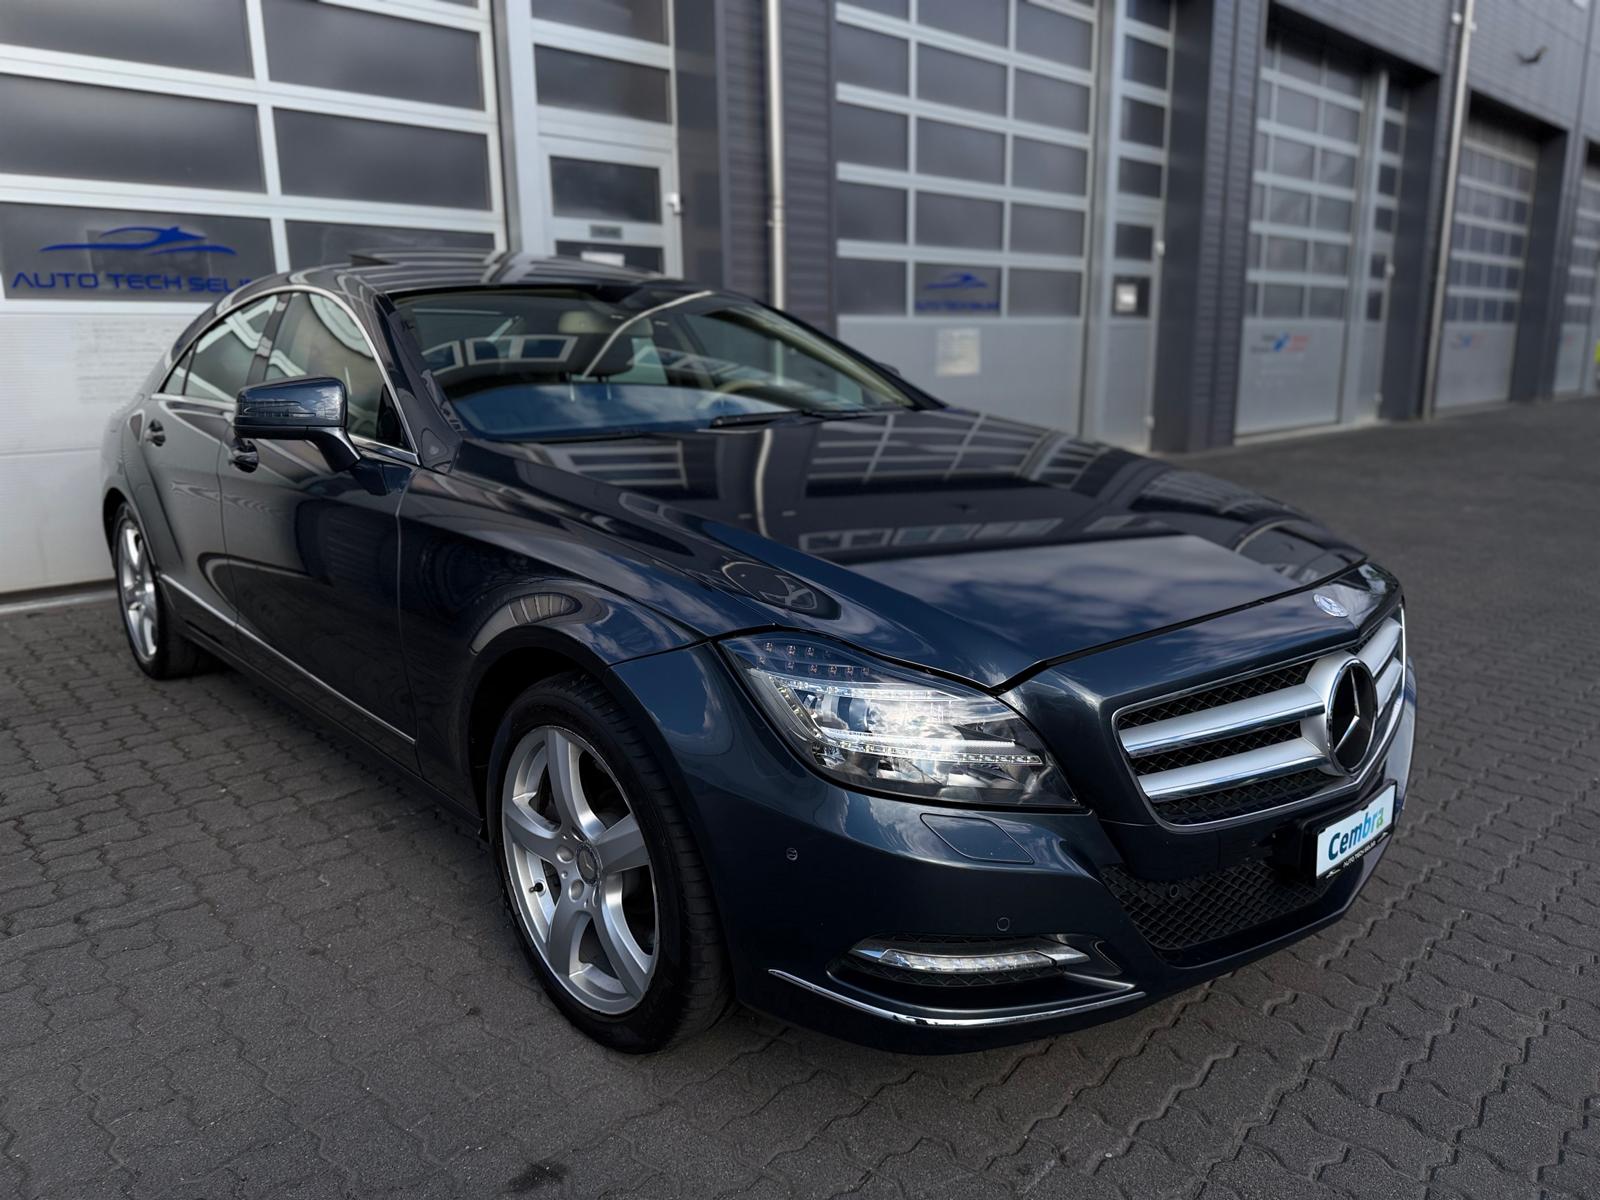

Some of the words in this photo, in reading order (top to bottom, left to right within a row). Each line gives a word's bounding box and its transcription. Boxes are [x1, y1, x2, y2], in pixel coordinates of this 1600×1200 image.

[12, 272, 98, 289] AUTO
[106, 273, 182, 290] TECH
[1328, 807, 1384, 861] Cembra
